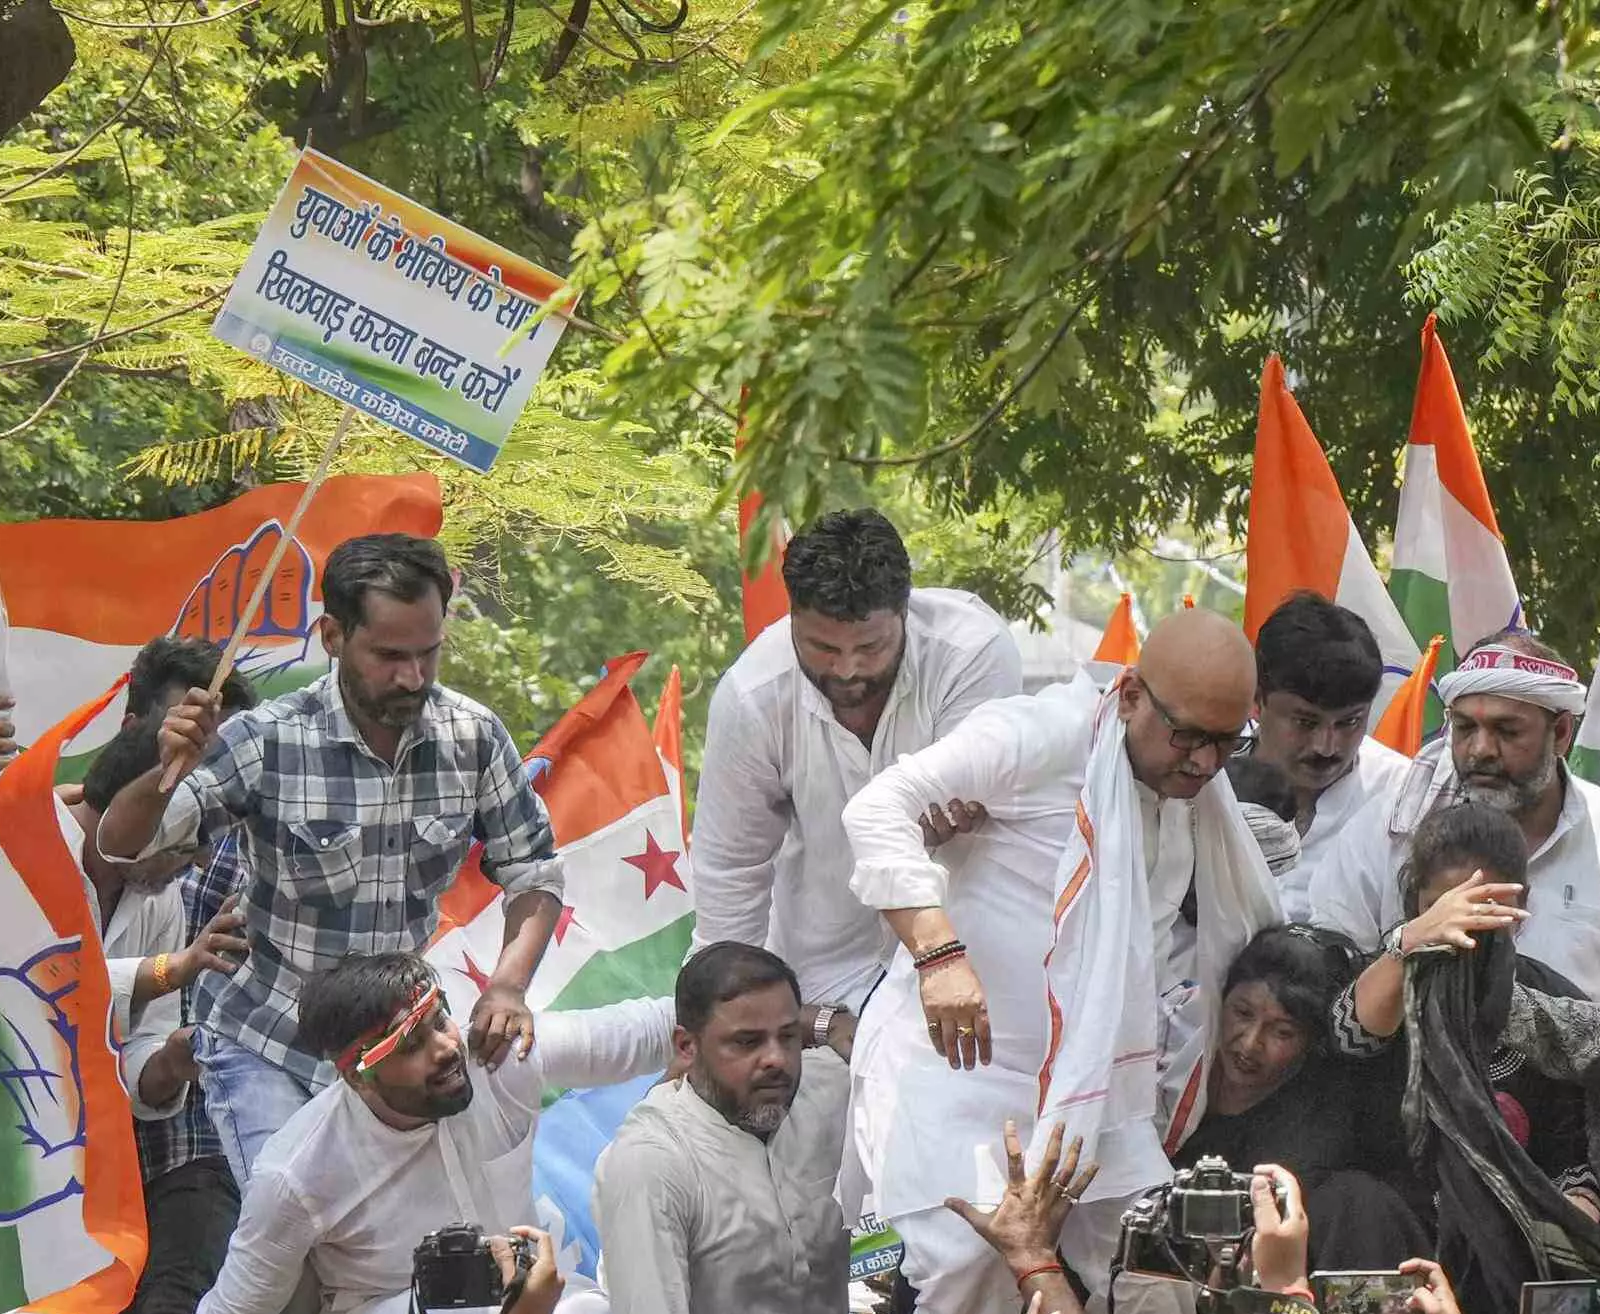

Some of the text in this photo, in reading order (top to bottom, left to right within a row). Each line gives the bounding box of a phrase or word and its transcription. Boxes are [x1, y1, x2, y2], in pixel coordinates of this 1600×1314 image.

[290, 186, 380, 250] युवाओं
[367, 217, 402, 262] के
[256, 250, 356, 343] खिलवाड़
[350, 305, 418, 364] करना
[414, 338, 466, 389] बन्द
[318, 367, 360, 400] प्रदेश
[418, 418, 469, 455] कमेटी
